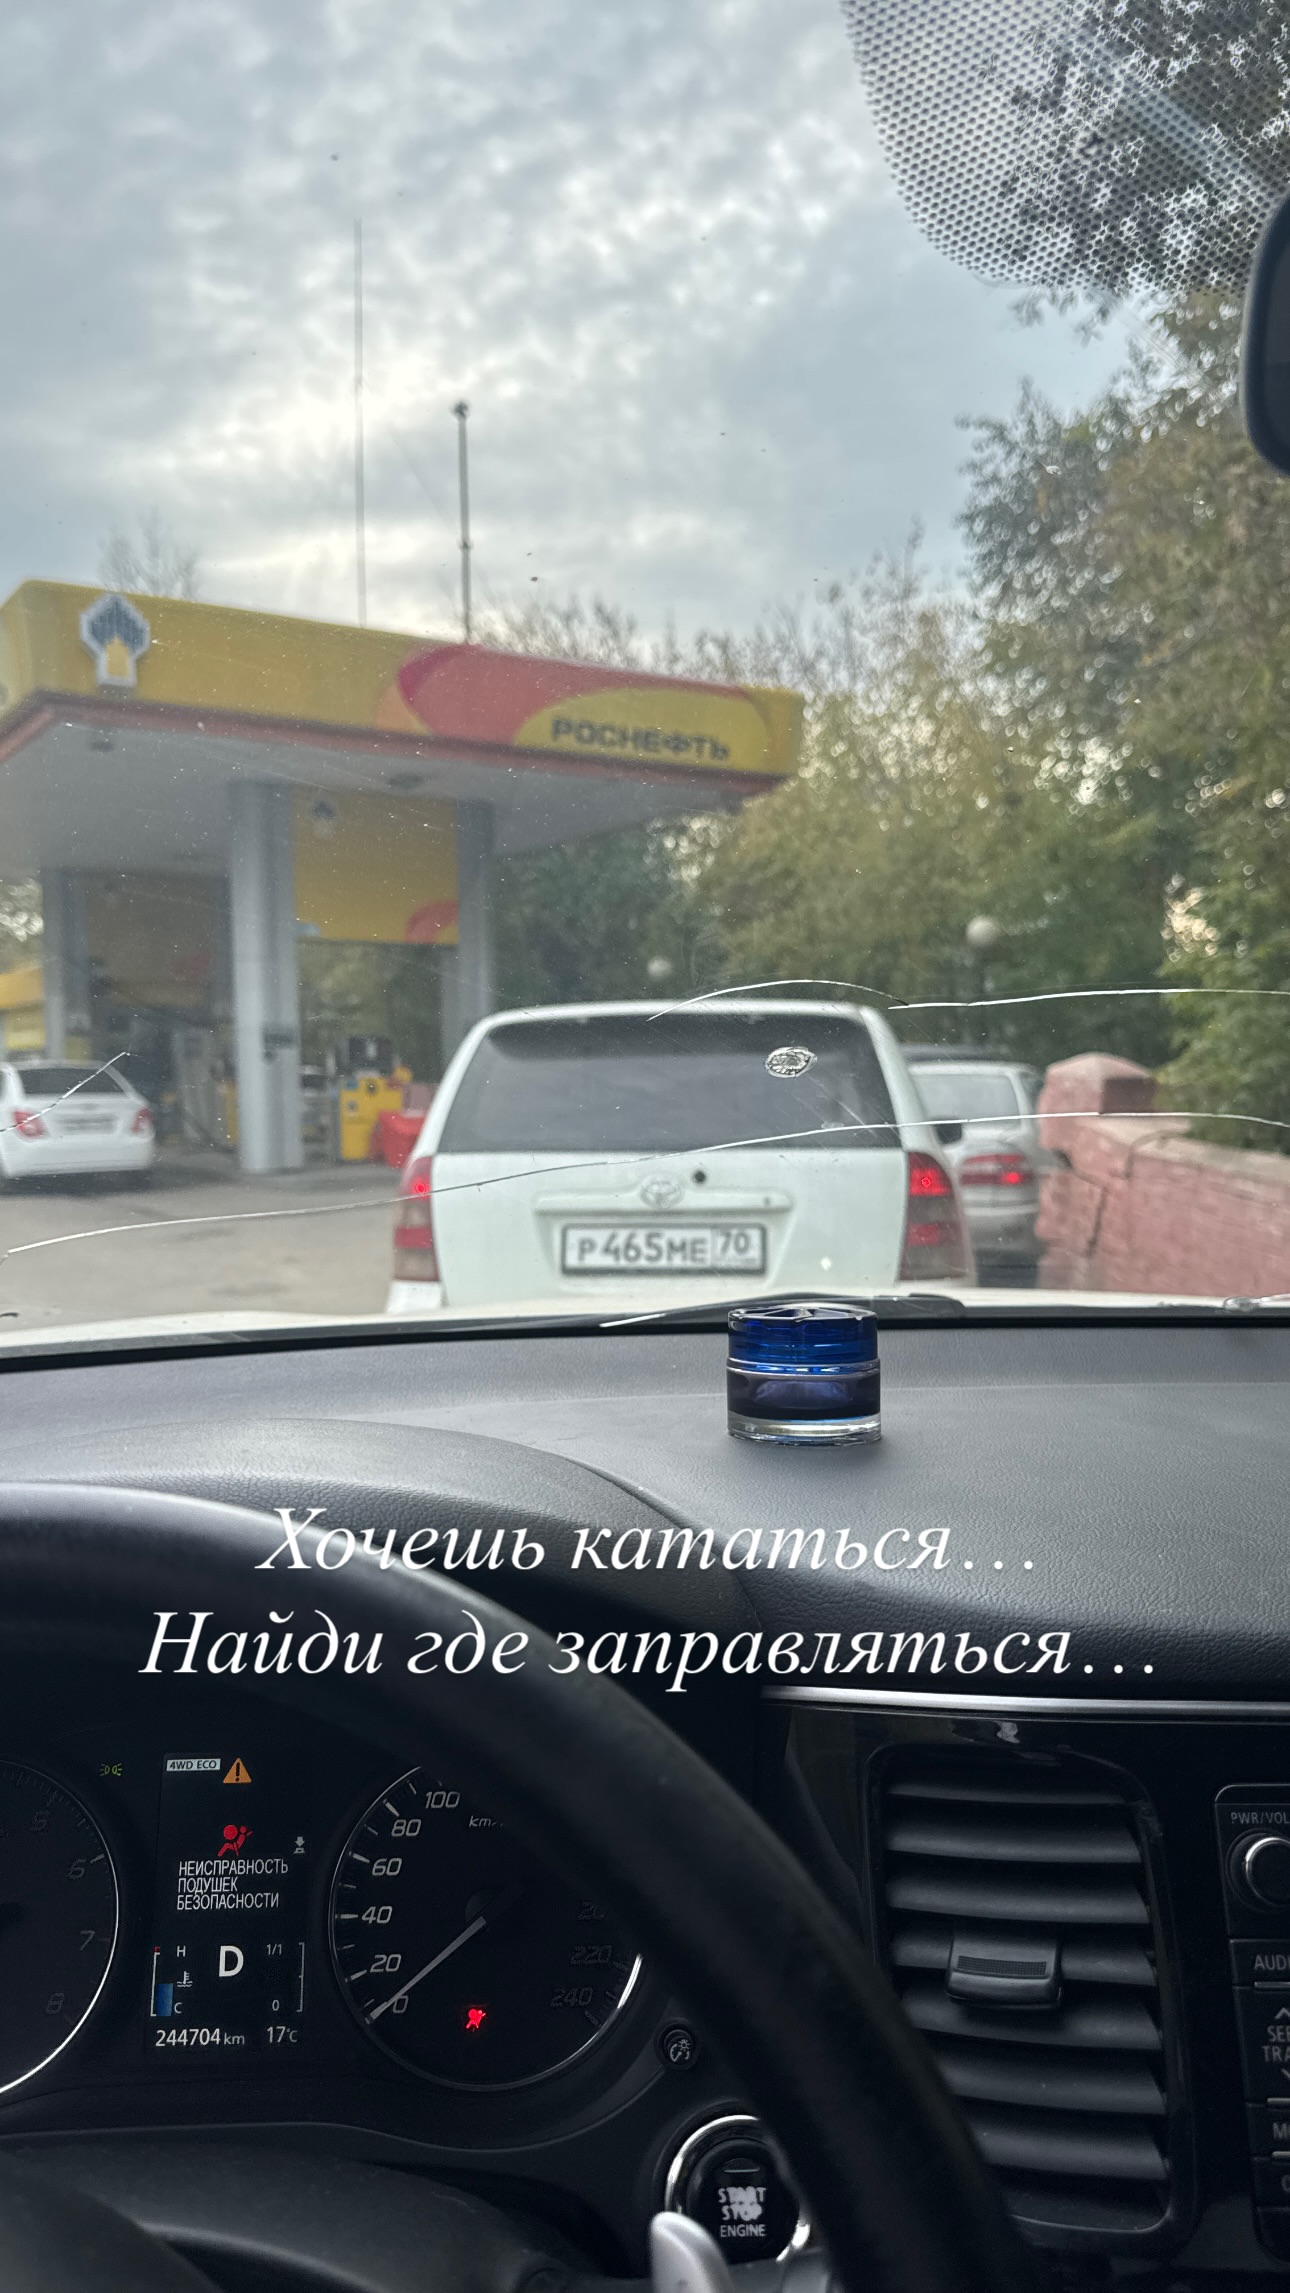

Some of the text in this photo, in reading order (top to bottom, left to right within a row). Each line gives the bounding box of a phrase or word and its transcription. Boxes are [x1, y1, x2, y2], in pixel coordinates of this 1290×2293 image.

[552, 716, 730, 761] РОСНЕФТЬ
[721, 1231, 749, 1256] 70
[169, 1759, 217, 1770] 4WD ECO
[425, 1791, 460, 1809] 100
[1230, 1811, 1290, 1825] PWR/VOL
[391, 1819, 421, 1837] 80
[178, 1858, 289, 1876] НЕИСПРАВНОСТЬ
[371, 1858, 402, 1876] 60
[177, 1876, 239, 1895] ПОДУШЕК
[176, 1892, 280, 1911] БЕЗОПАСНОСТИ
[361, 1906, 392, 1924] 40
[79, 1929, 96, 1950] 7
[176, 1945, 187, 1957] H
[266, 1943, 283, 1956] 1/1
[218, 1945, 244, 1977] D
[370, 1954, 401, 1973] 20
[173, 2002, 183, 2014] C
[271, 1999, 280, 2012] 0
[392, 1995, 409, 2014] 0
[155, 2027, 245, 2047] 244704 km
[720, 2223, 767, 2238] ENGINE
